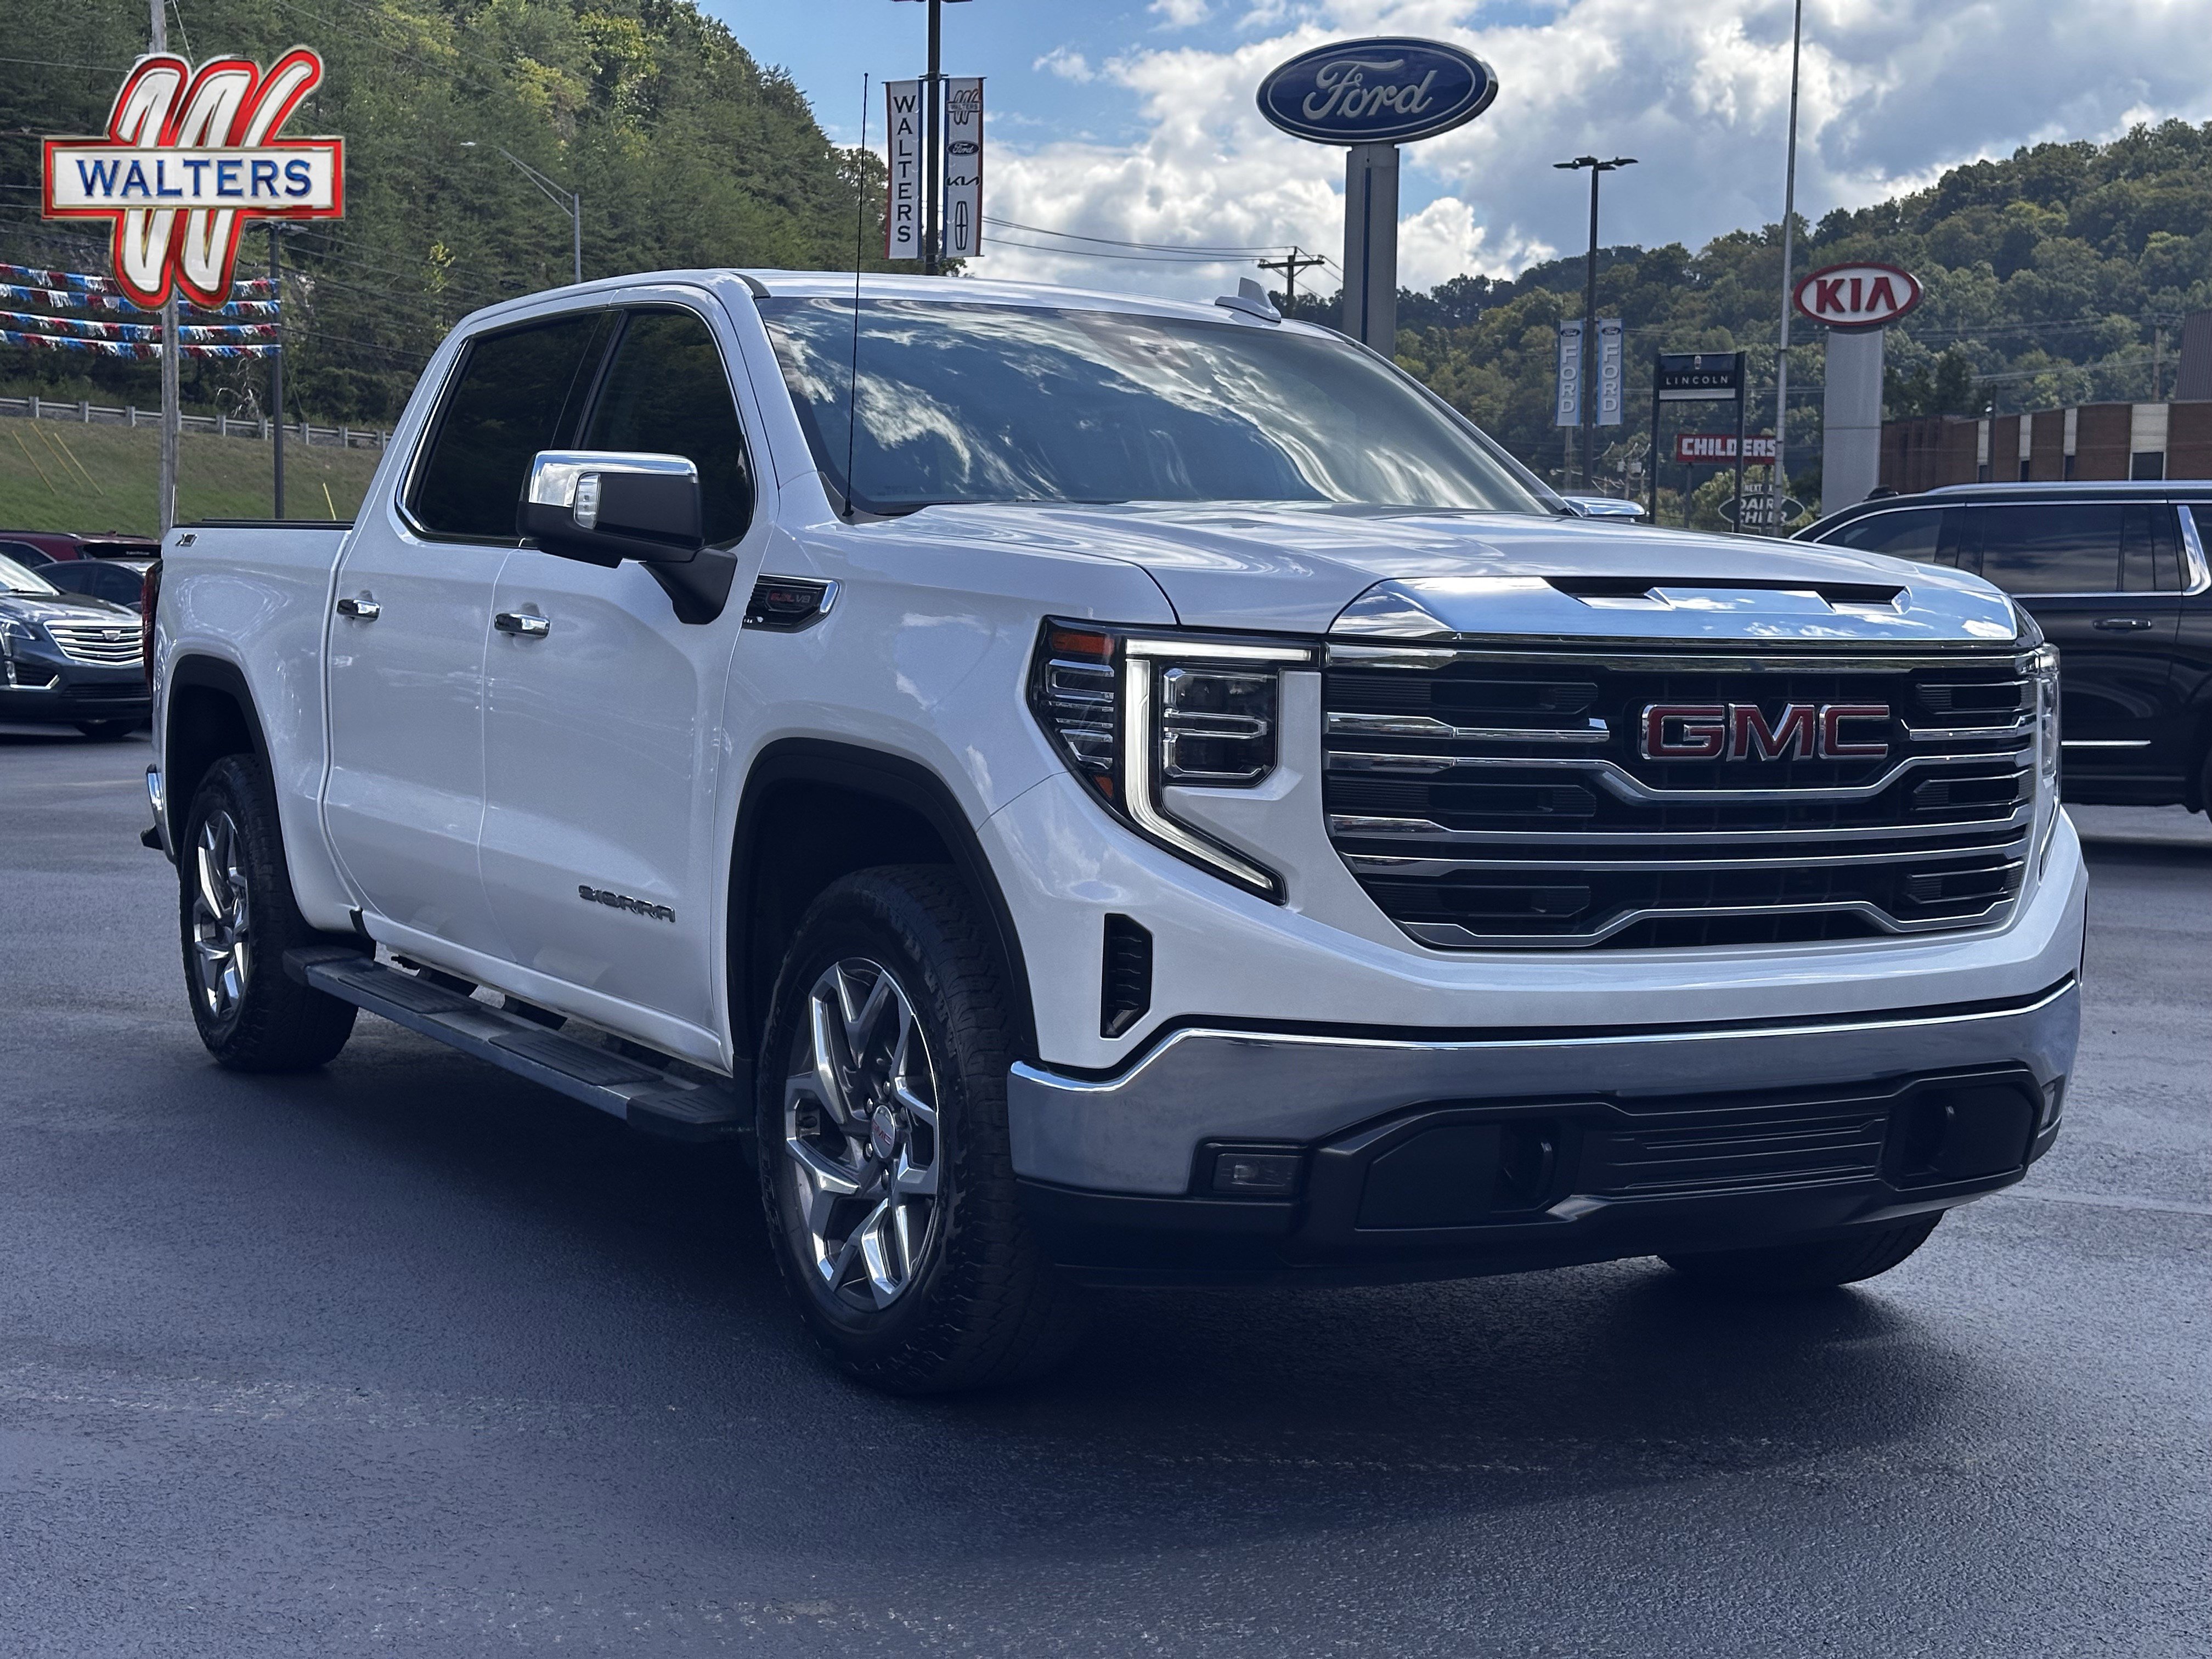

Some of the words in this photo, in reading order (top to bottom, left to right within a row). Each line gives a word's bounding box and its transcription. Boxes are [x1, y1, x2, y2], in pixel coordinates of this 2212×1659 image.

[1302, 58, 1438, 120] Ford
[893, 94, 917, 242] WALTERS
[952, 143, 974, 154] Ford
[1815, 276, 1898, 313] KIA
[1561, 345, 1578, 414] FORD
[1602, 343, 1620, 413] FORD
[1666, 375, 1729, 385] LINCOLN
[1641, 703, 1889, 761] GMC
[578, 884, 676, 923] SIERRA
[871, 1118, 892, 1146] GMC
